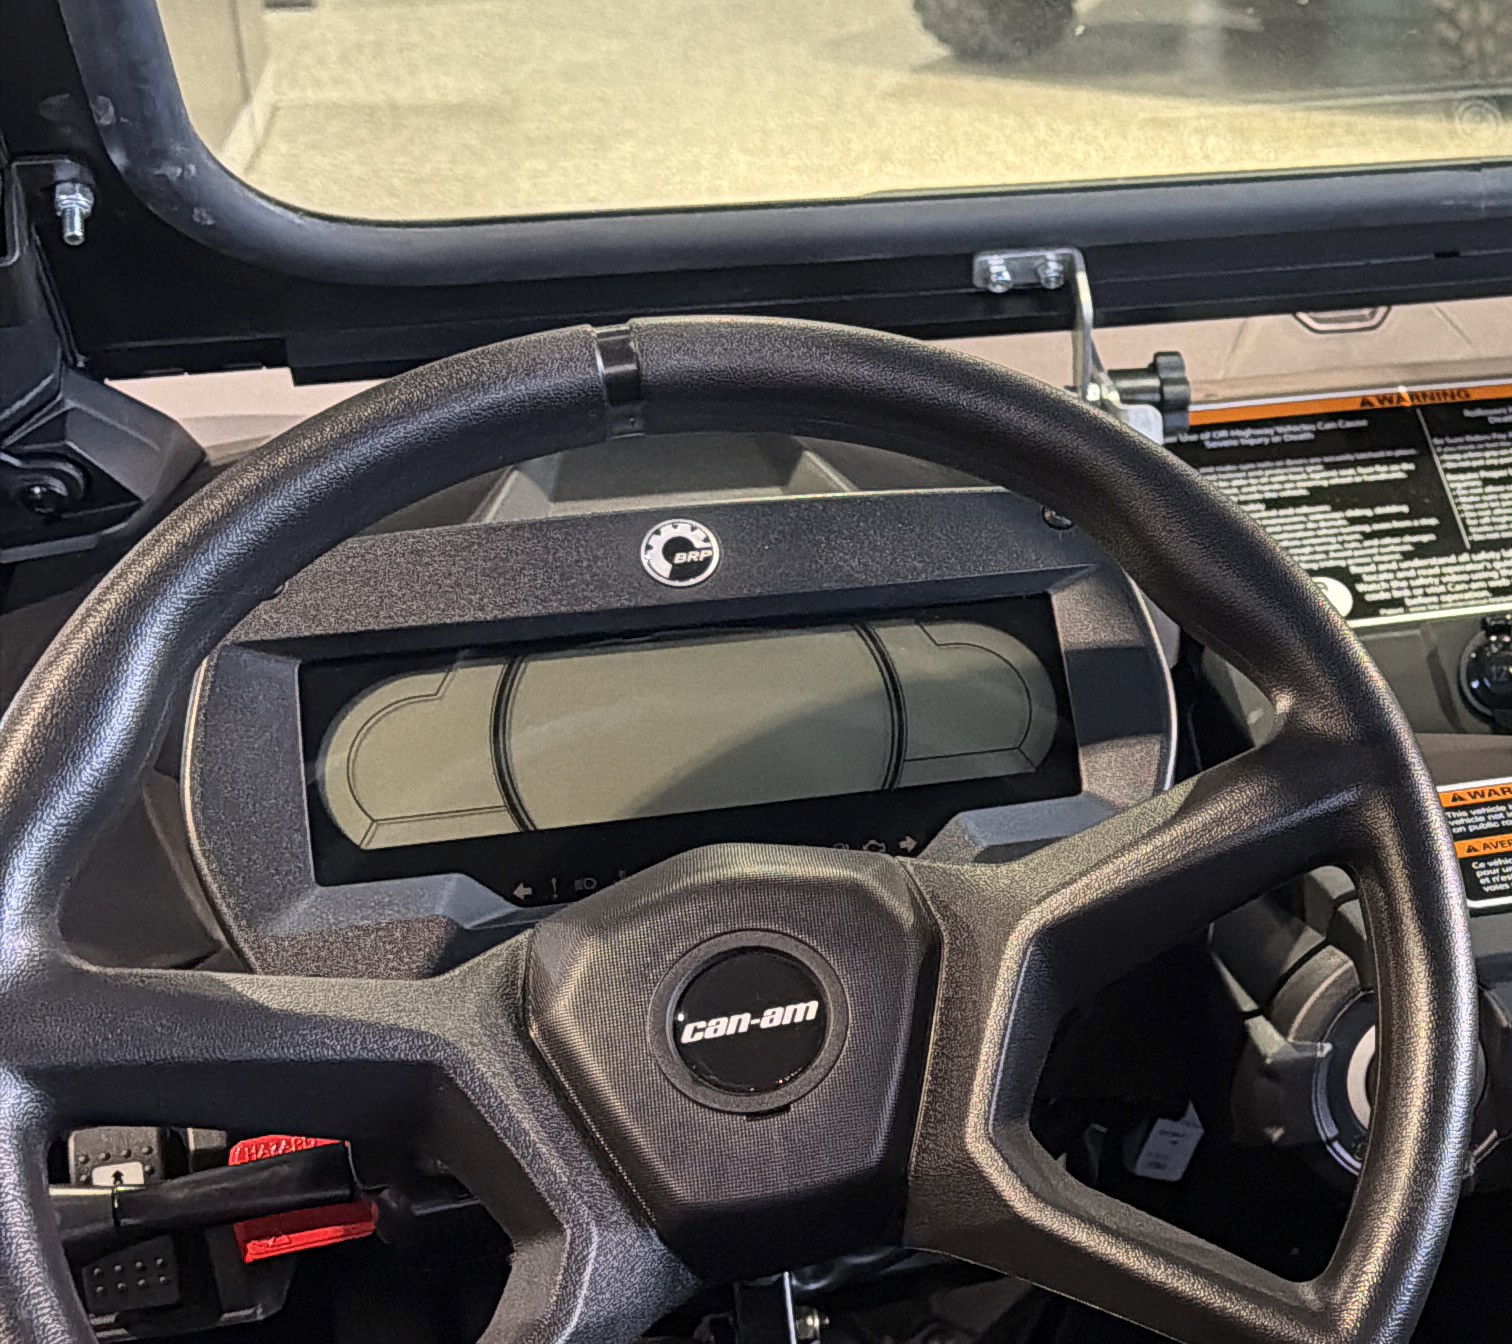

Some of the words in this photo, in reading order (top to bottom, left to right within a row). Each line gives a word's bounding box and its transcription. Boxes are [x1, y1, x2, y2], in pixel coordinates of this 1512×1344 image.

[673, 550, 712, 564] BRP
[1445, 810, 1468, 819] This
[1469, 804, 1506, 815] vehicle
[1448, 815, 1485, 826] vehicle
[1487, 812, 1504, 820] not
[1451, 825, 1466, 833] on
[1467, 821, 1499, 832] public
[680, 1000, 819, 1044] can-am
